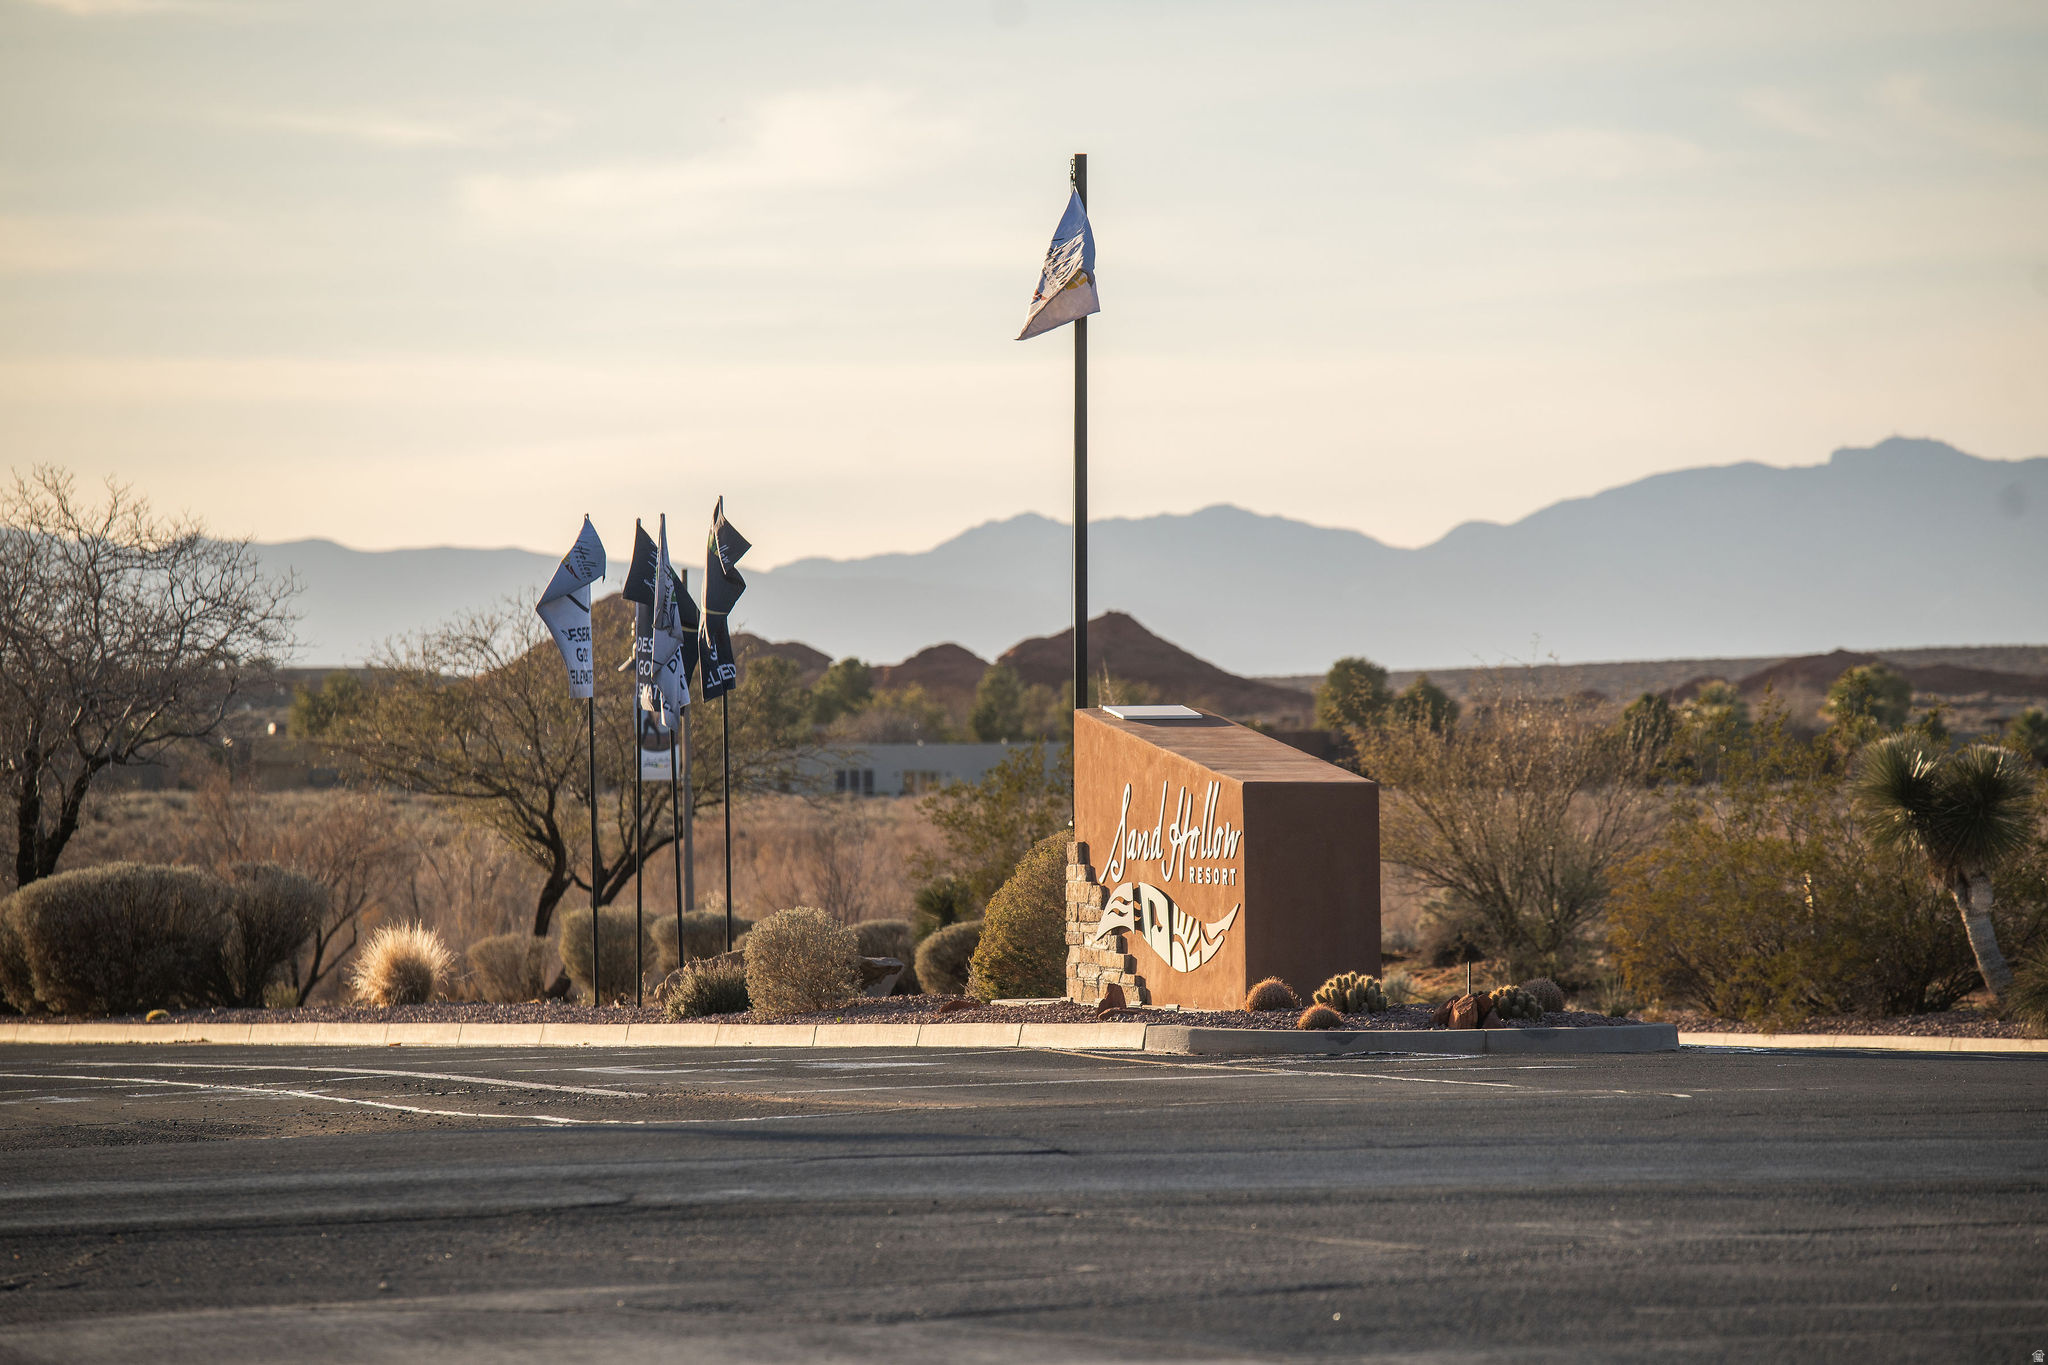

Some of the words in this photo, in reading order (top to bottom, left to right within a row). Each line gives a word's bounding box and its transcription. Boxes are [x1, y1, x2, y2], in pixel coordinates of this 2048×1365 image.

[637, 637, 653, 653] DES
[639, 660, 651, 676] GO
[1099, 782, 1167, 884] Sand
[1161, 780, 1242, 882] Hollow
[1189, 867, 1237, 886] RESORT
